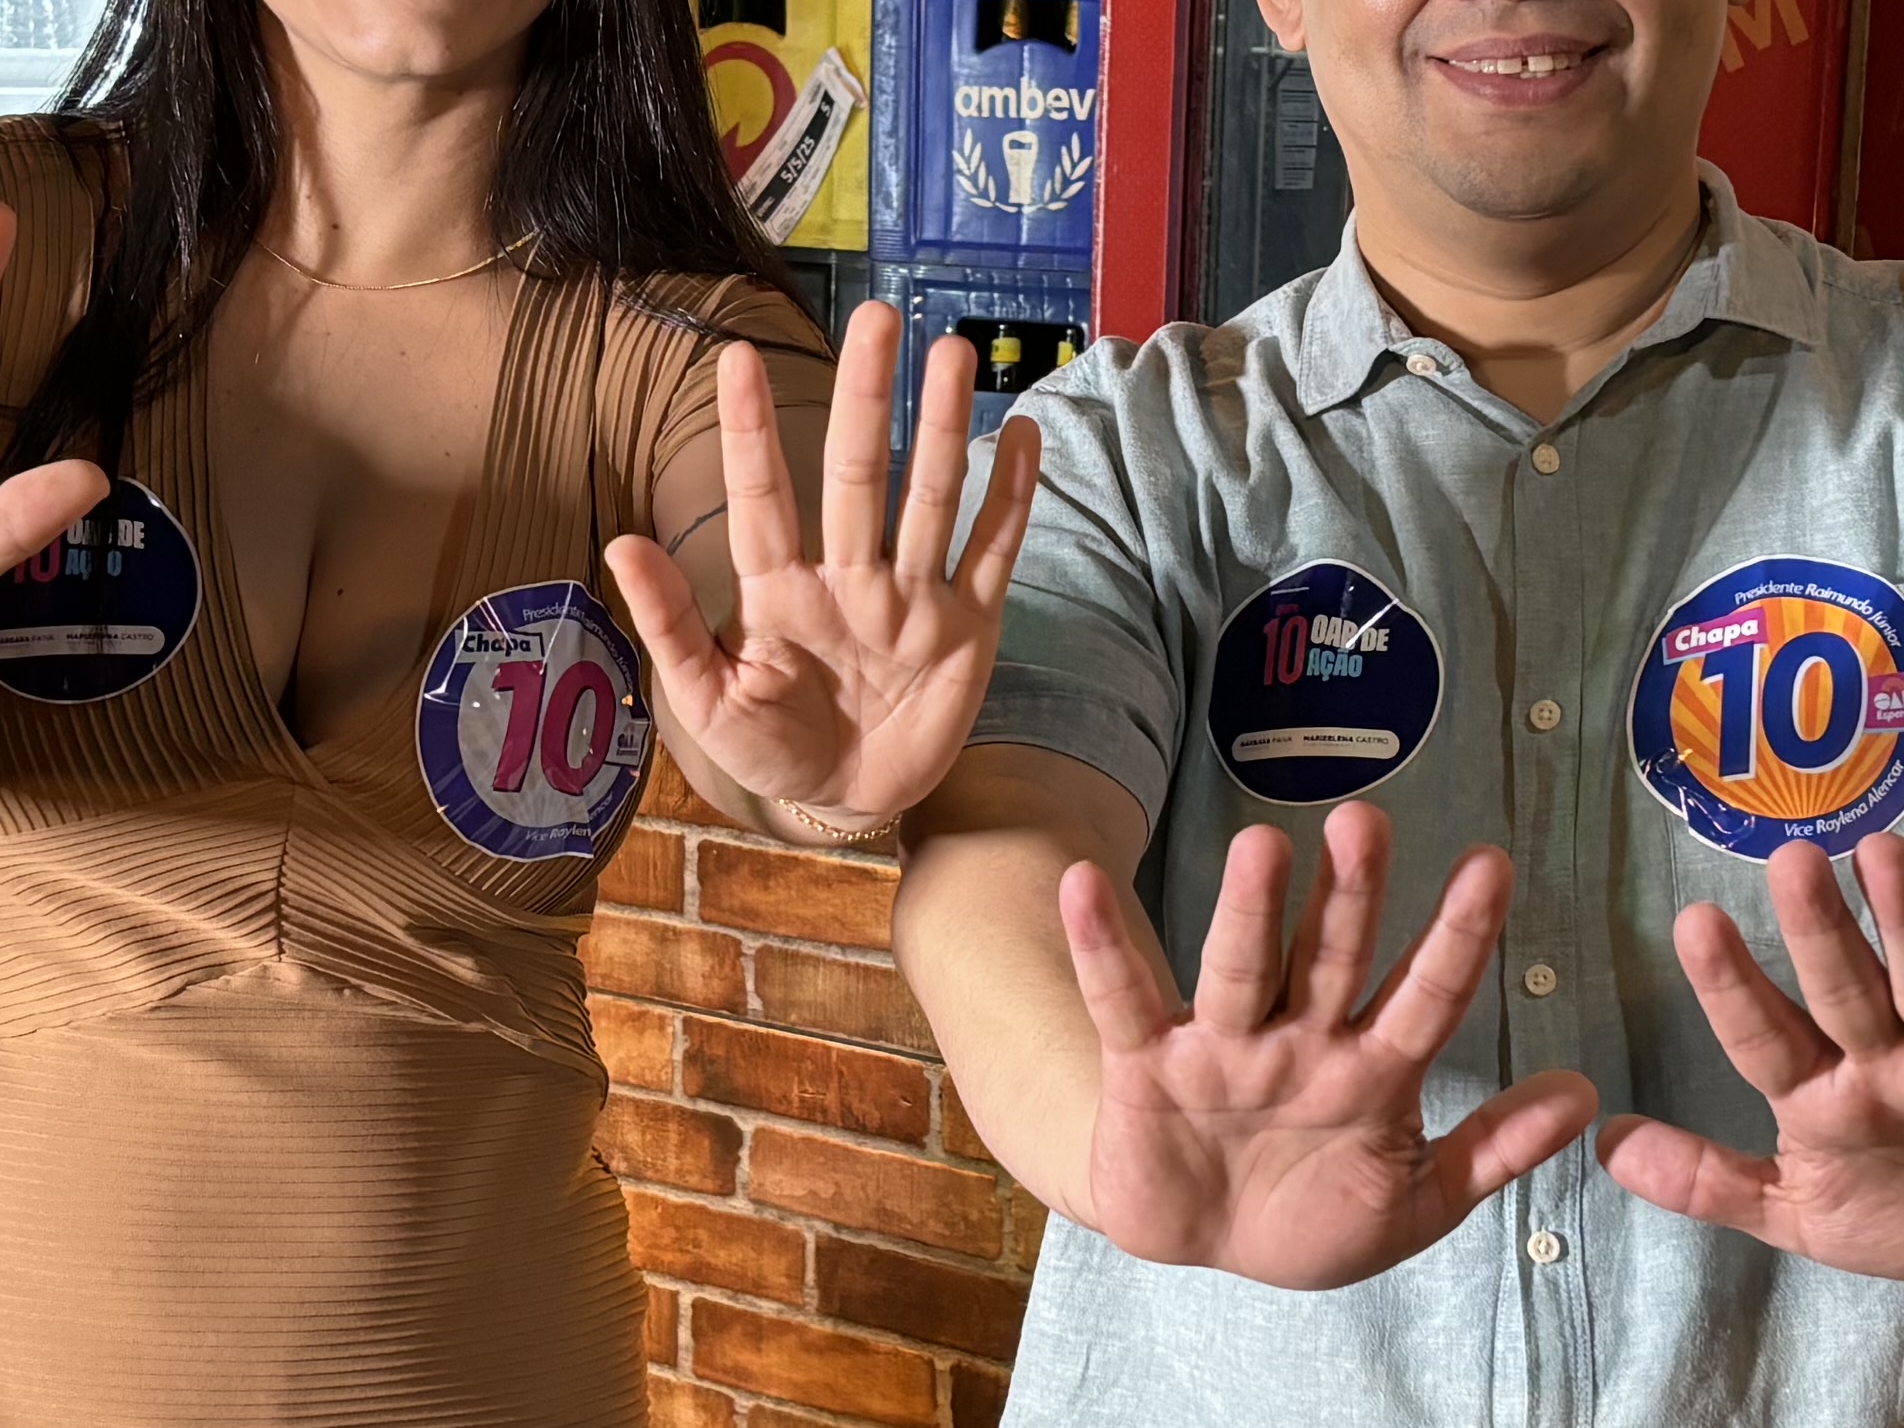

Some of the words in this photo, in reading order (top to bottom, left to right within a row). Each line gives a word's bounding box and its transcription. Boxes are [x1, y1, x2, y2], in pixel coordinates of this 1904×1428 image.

[954, 75, 1097, 121] ambev
[117, 518, 146, 550] DE
[64, 548, 123, 582] AÇO
[1310, 613, 1359, 650] OAB
[1360, 626, 1391, 653] DE
[1734, 580, 1804, 606] Presidente
[1804, 583, 1875, 616] Raimundo
[1867, 608, 1903, 649] Júnior
[461, 632, 532, 657] Chapa
[1262, 615, 1309, 687] 10
[1674, 618, 1760, 653] Chapa
[1305, 647, 1364, 682] AÇÃO
[1699, 630, 1869, 782] 10
[491, 659, 617, 797] 10
[1784, 821, 1814, 838] Vice
[1815, 801, 1869, 836] Raylena
